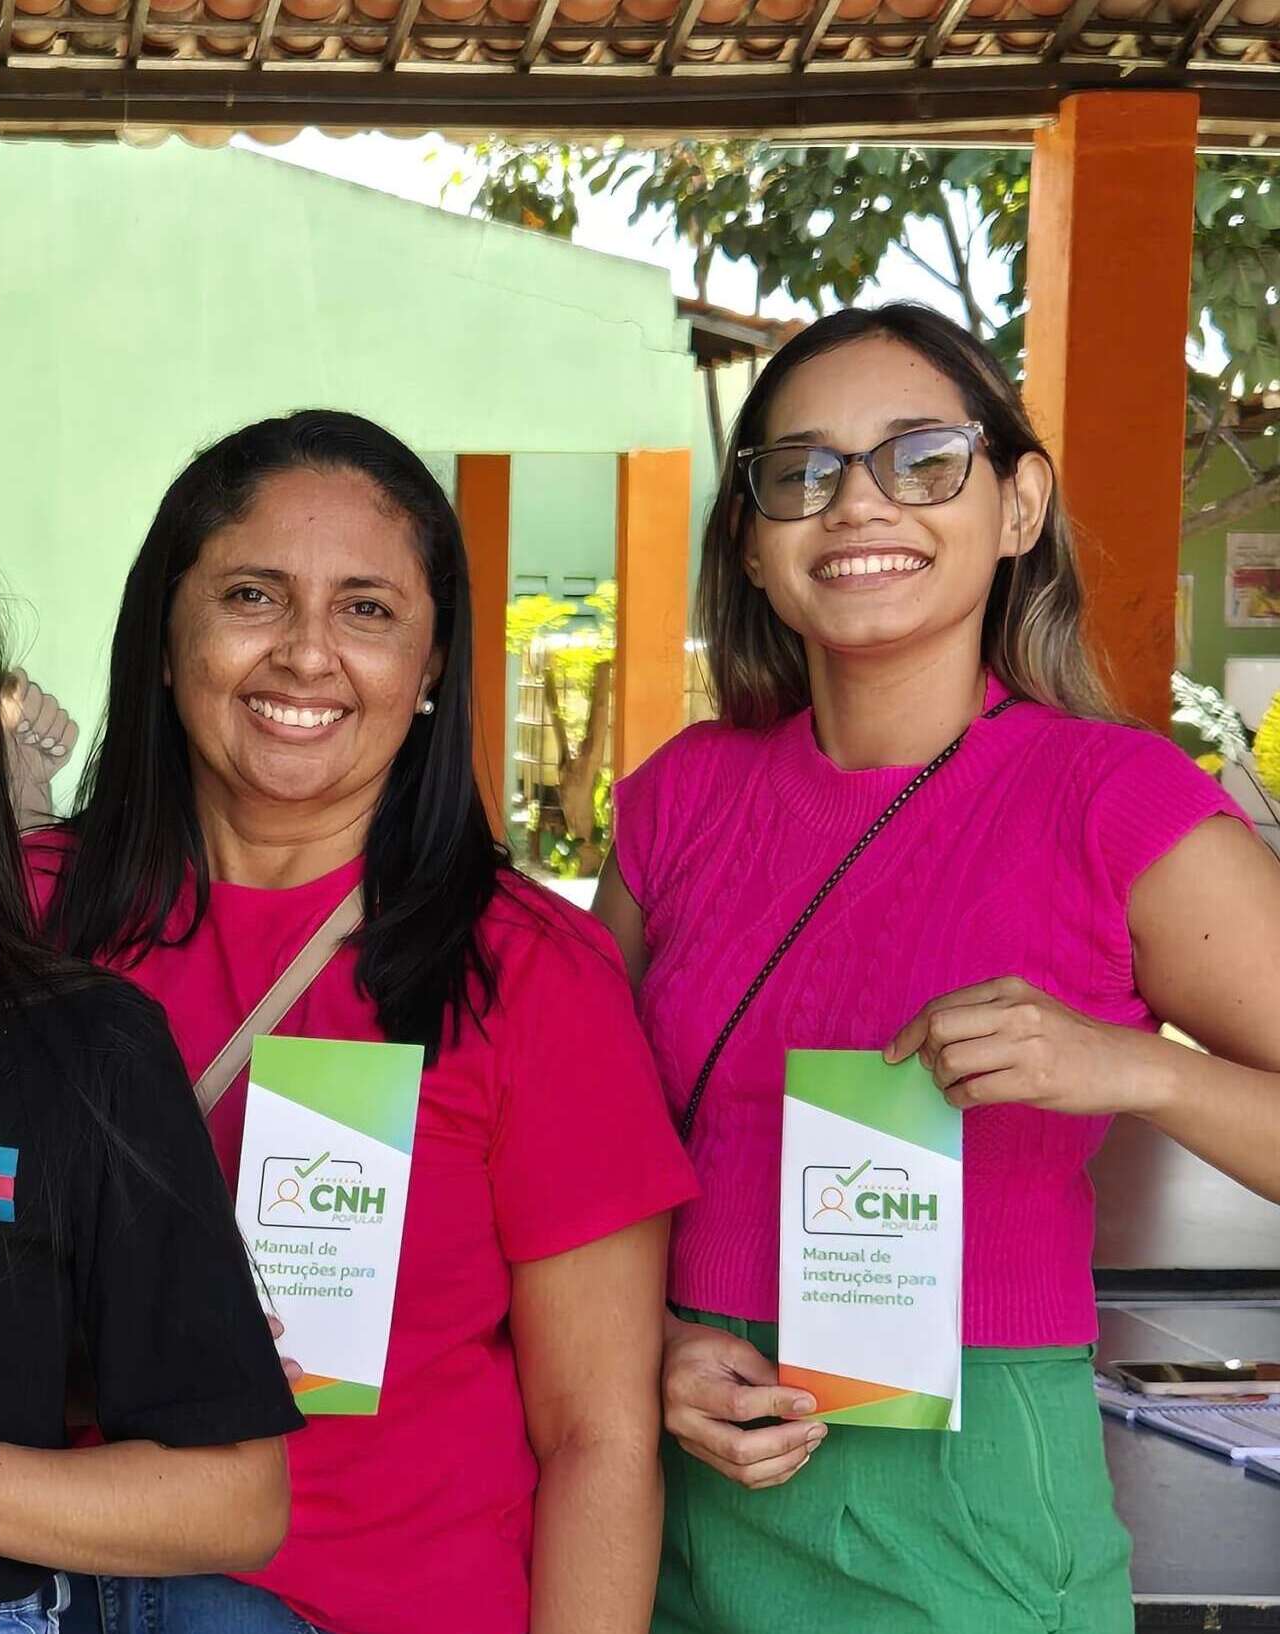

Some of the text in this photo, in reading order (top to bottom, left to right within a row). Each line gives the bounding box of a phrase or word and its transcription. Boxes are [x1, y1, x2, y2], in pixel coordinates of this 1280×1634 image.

[309, 1184, 386, 1214] CNH
[855, 1192, 938, 1221] CNH
[254, 1239, 338, 1256] Manual de
[802, 1247, 892, 1263] Manual de
[340, 1266, 376, 1281] para
[802, 1267, 937, 1288] instruções para
[801, 1290, 915, 1306] atendimento
